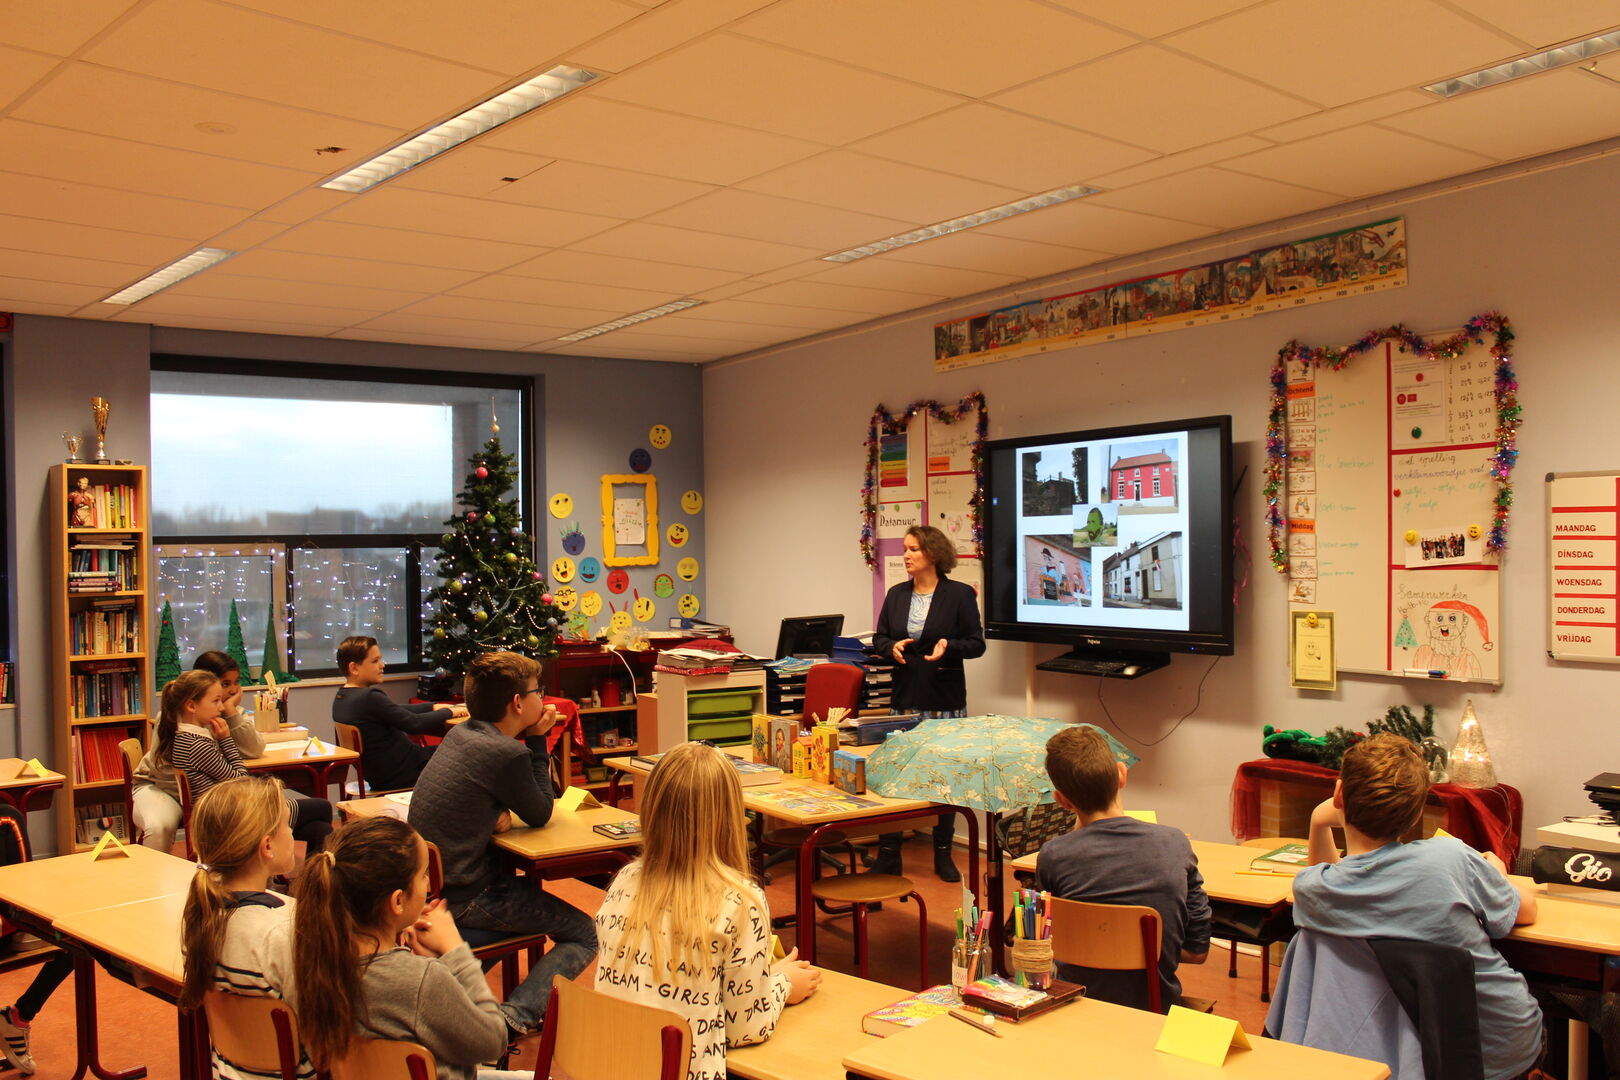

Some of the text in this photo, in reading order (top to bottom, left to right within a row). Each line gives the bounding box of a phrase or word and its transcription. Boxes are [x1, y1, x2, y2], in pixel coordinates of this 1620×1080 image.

[1291, 523, 1314, 531] Middag
[1555, 524, 1596, 532] MAANDAG
[1556, 578, 1602, 586] WOENSDAG
[1556, 606, 1605, 614] DONDERDAG
[1556, 633, 1592, 643] VRIJDAG
[1564, 853, 1612, 883] Gio
[598, 966, 639, 992] DREAM
[658, 983, 710, 1006] GIRLS
